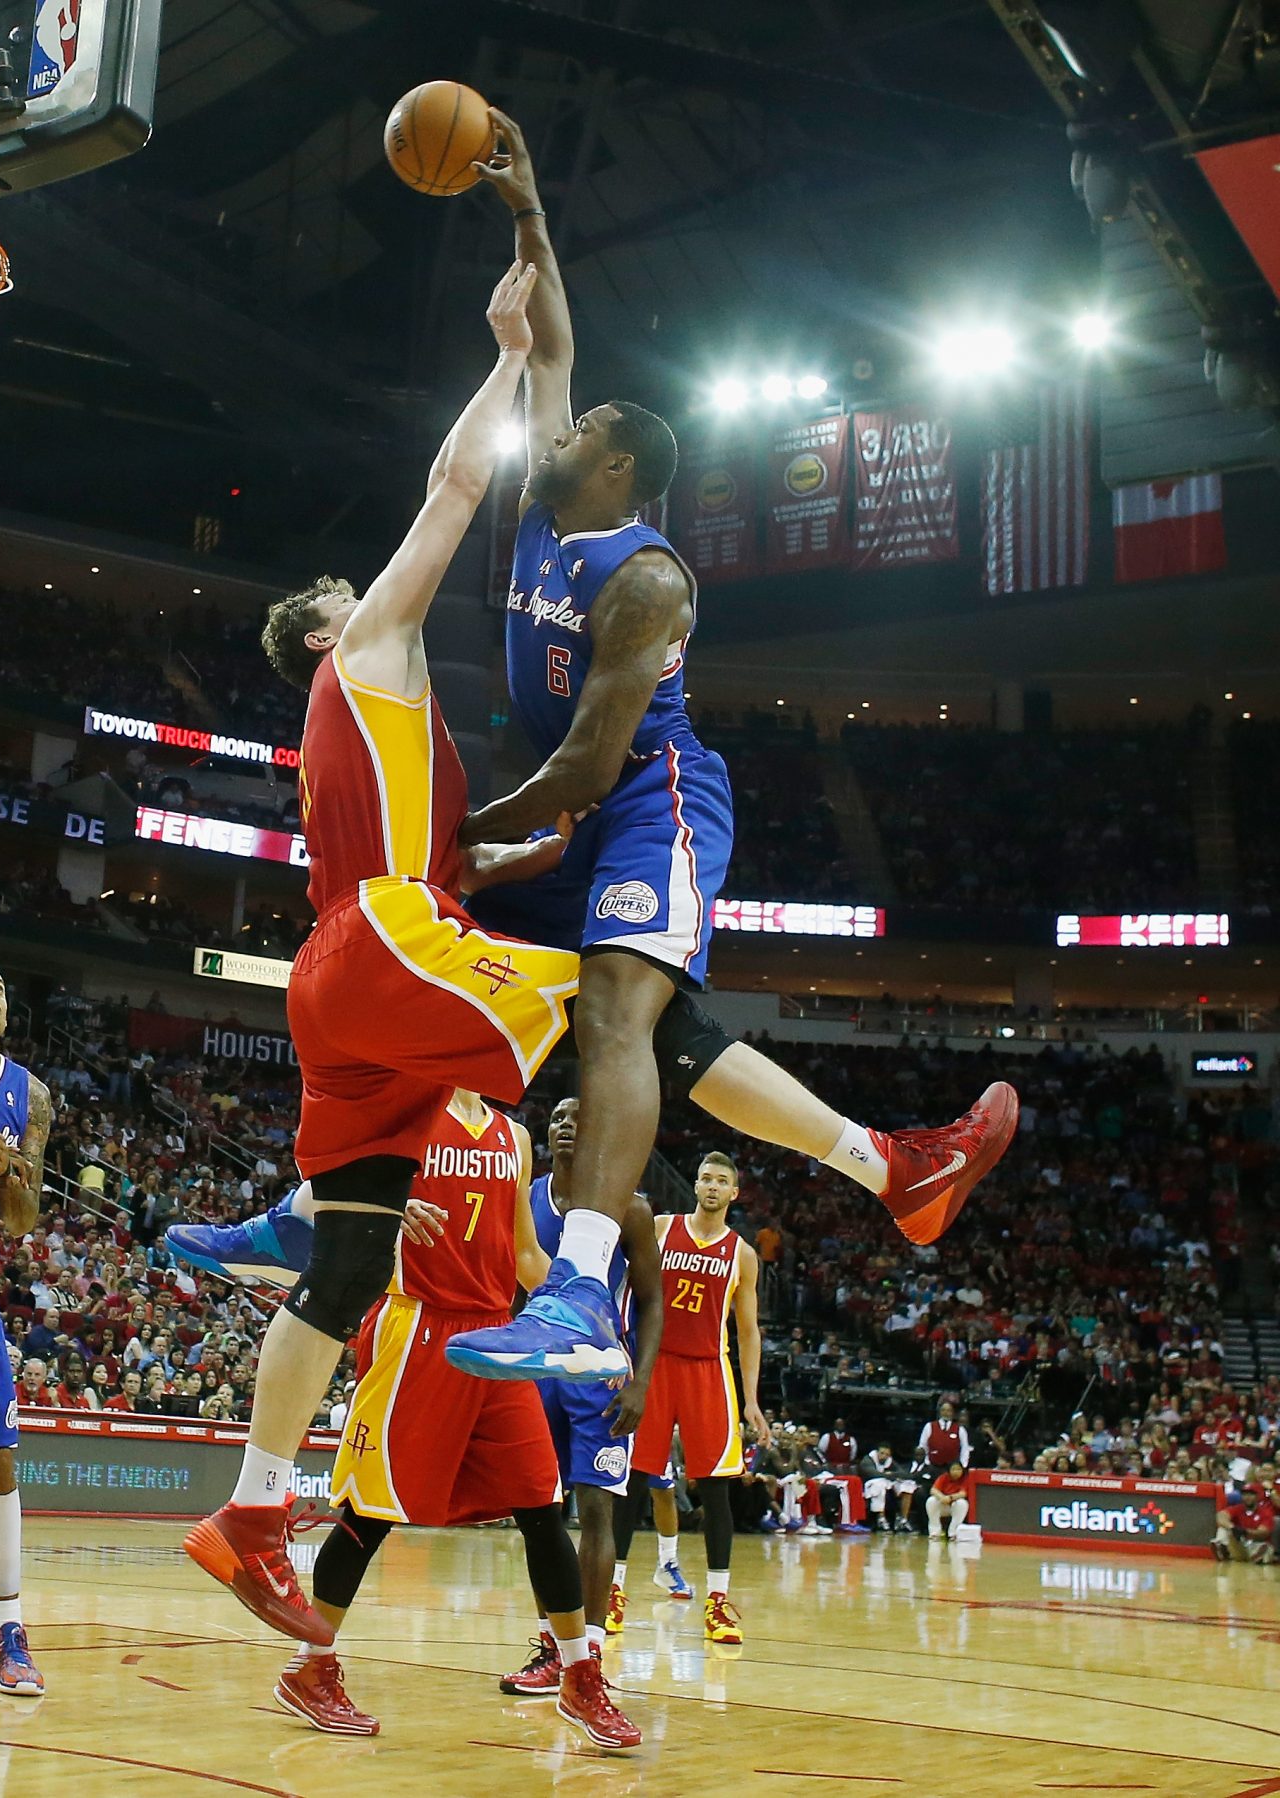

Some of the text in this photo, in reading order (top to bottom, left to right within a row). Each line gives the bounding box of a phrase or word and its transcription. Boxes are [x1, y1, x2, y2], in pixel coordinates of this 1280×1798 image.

[525, 585, 588, 633] Angeles
[547, 644, 571, 698] 6
[91, 710, 302, 769] TOYOTATRUCKMONTH.CO
[135, 806, 256, 858] FENSE
[598, 895, 651, 916] CLIPPERS
[1196, 1057, 1239, 1072] reliant
[423, 1143, 519, 1181] HOUSTON
[464, 1192, 485, 1242] 7
[661, 1250, 732, 1278] HOUSTON
[671, 1278, 706, 1314] 25
[14, 1459, 191, 1491] ING THE ENERGY!
[287, 1465, 332, 1500] liant
[1039, 1501, 1140, 1534] reliant
